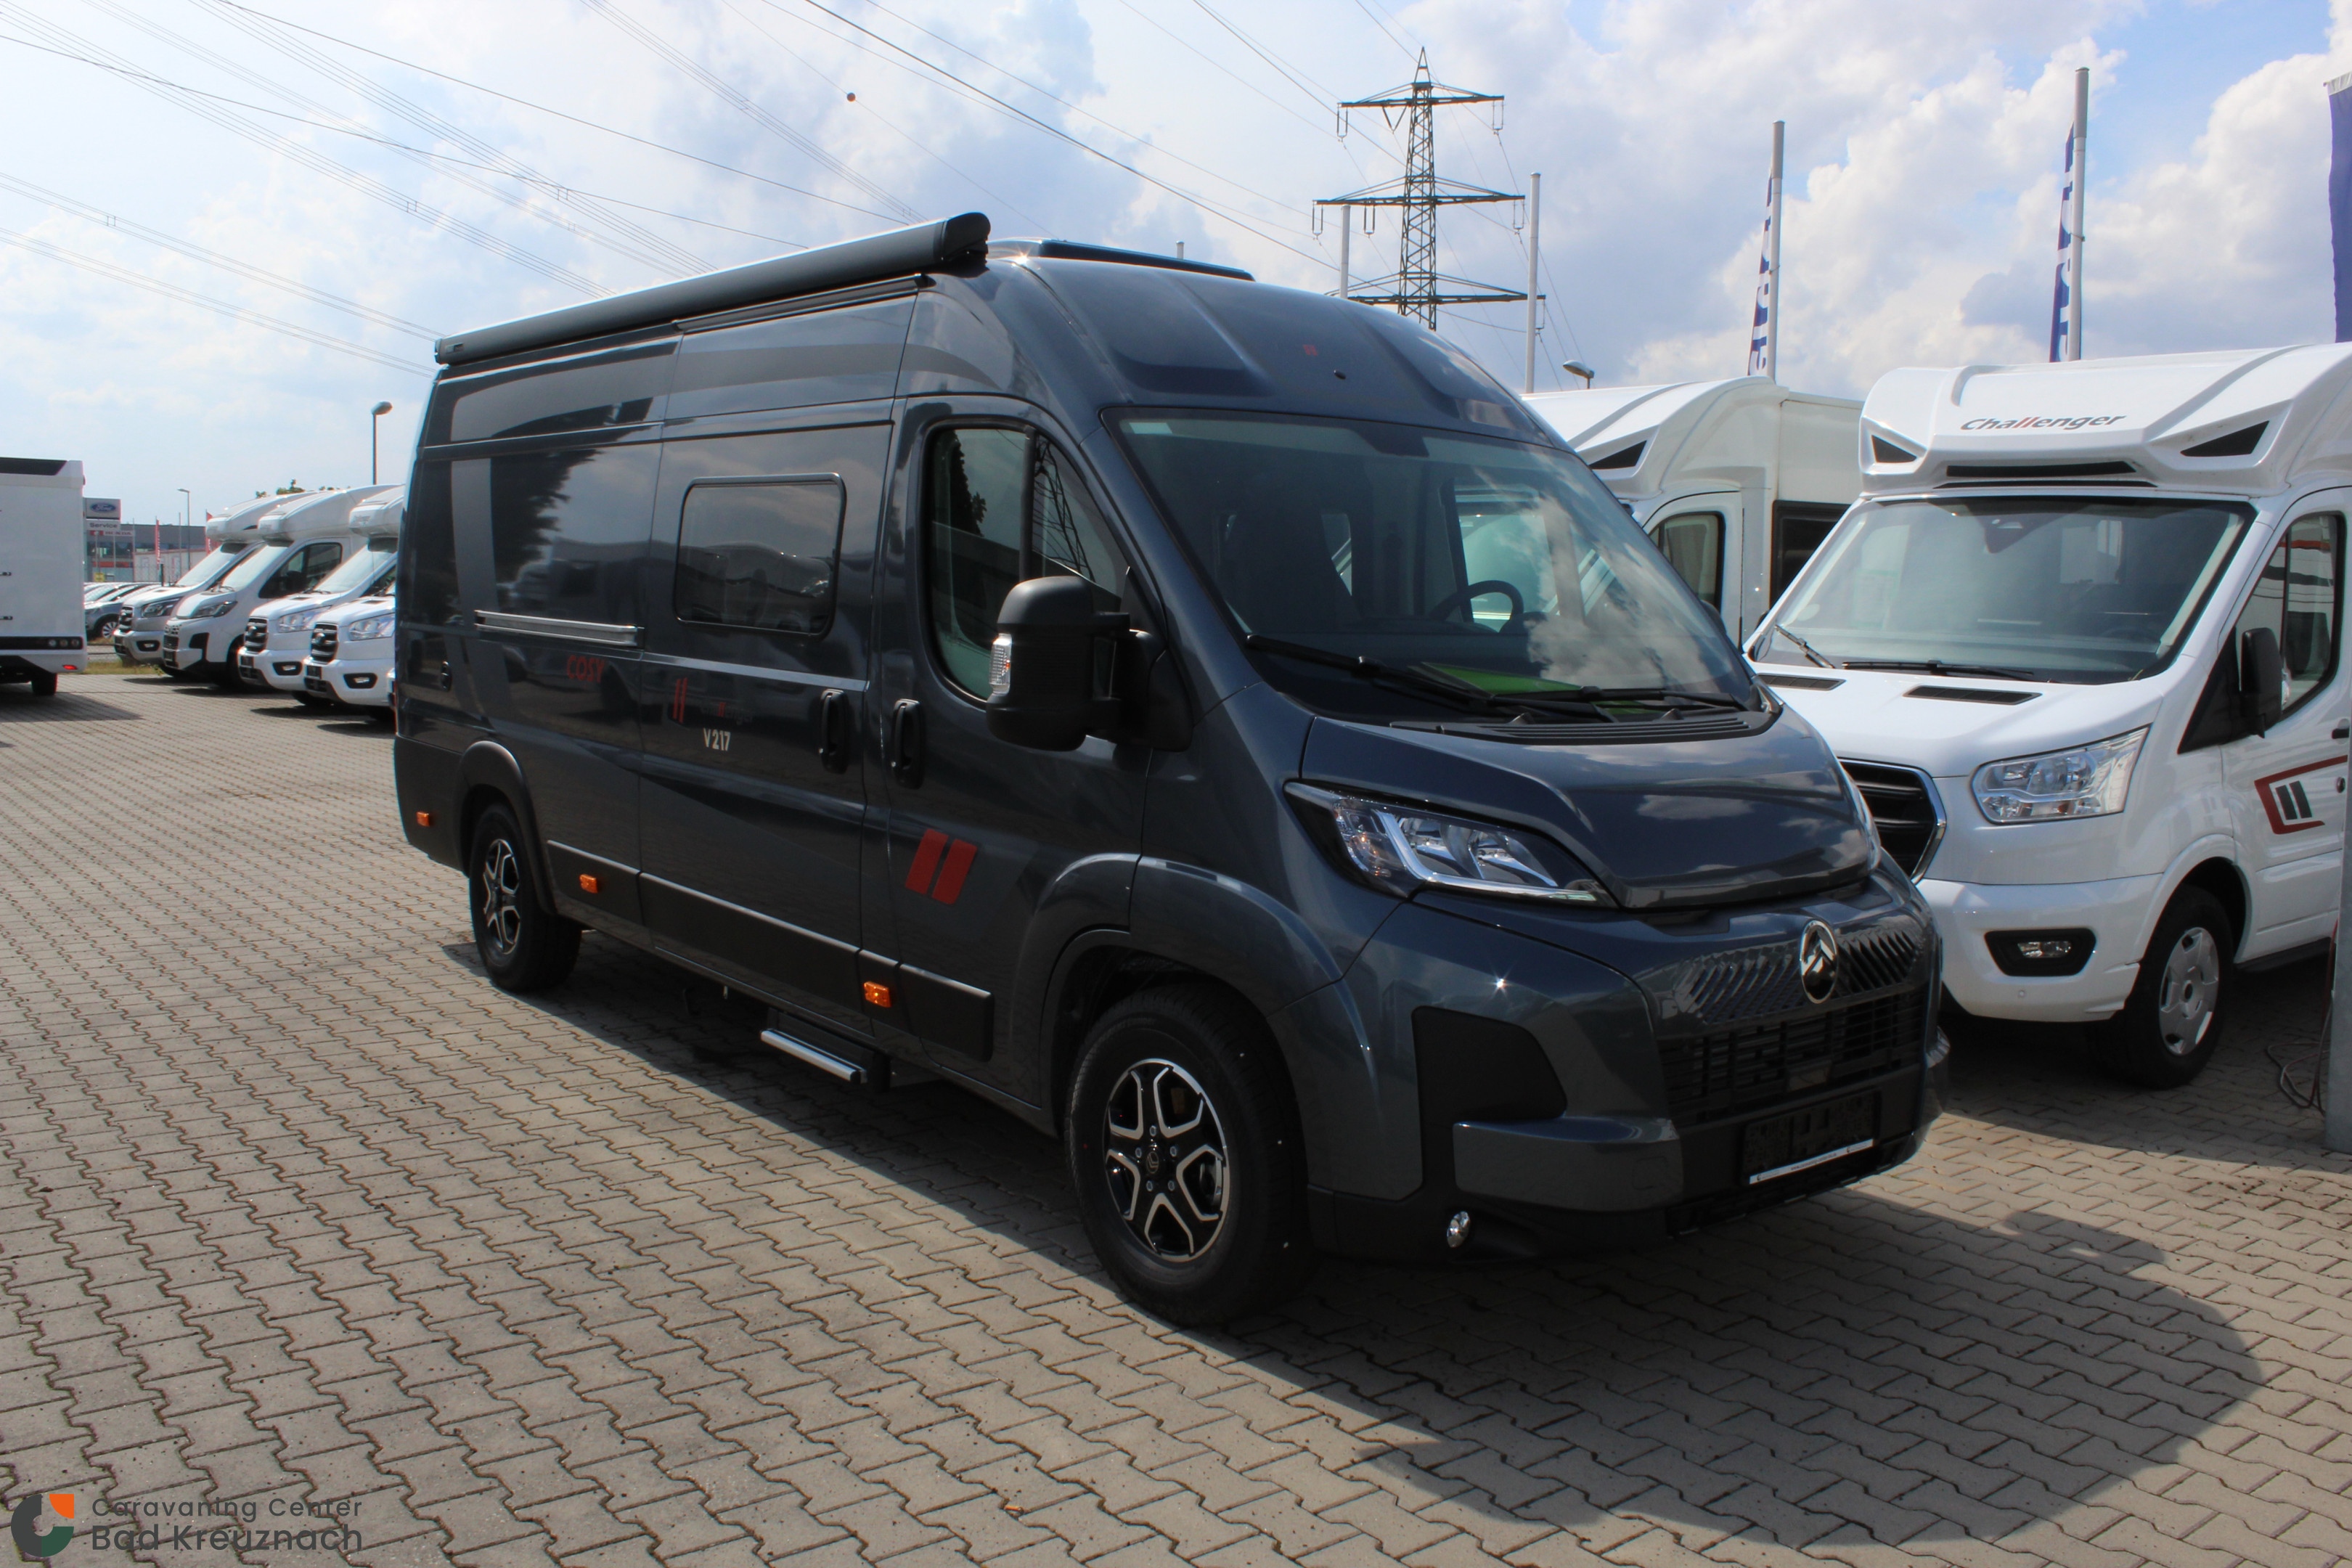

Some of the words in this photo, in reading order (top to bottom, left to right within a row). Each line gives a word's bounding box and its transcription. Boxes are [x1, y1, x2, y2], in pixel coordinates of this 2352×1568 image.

[1961, 415, 2127, 430] Challenger
[566, 654, 605, 683] COSY
[703, 727, 731, 751] V217
